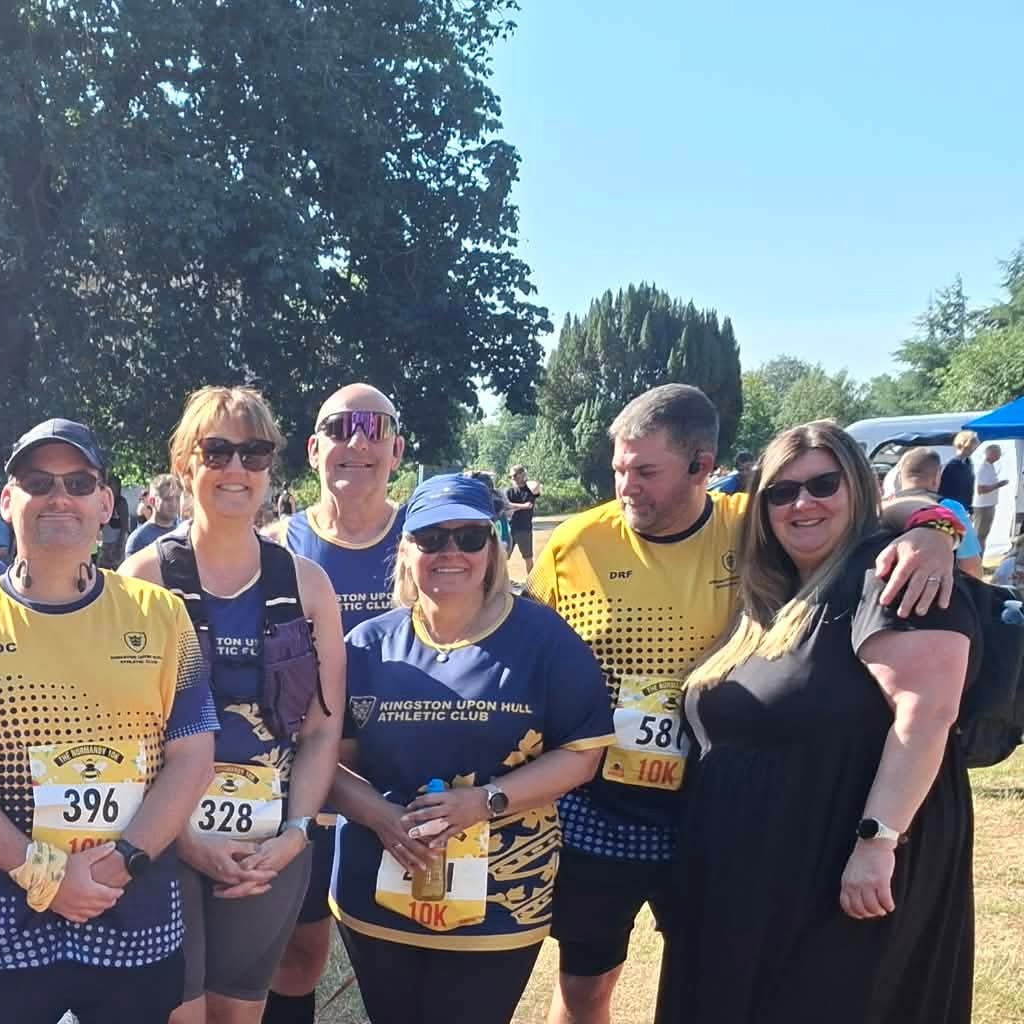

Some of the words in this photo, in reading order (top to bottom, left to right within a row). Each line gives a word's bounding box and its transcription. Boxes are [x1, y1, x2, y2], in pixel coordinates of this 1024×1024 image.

[609, 570, 633, 580] DRF
[370, 592, 394, 601] UPO
[366, 601, 393, 610] CLU
[379, 700, 452, 711] KINGSTON
[456, 700, 497, 711] UPON
[500, 702, 533, 714] HULL
[377, 711, 447, 722] ATHLETIC
[450, 712, 489, 721] CLUB
[638, 759, 679, 784] 10K
[63, 788, 119, 823] 396
[198, 799, 253, 833] 328
[408, 902, 448, 927] 10K
